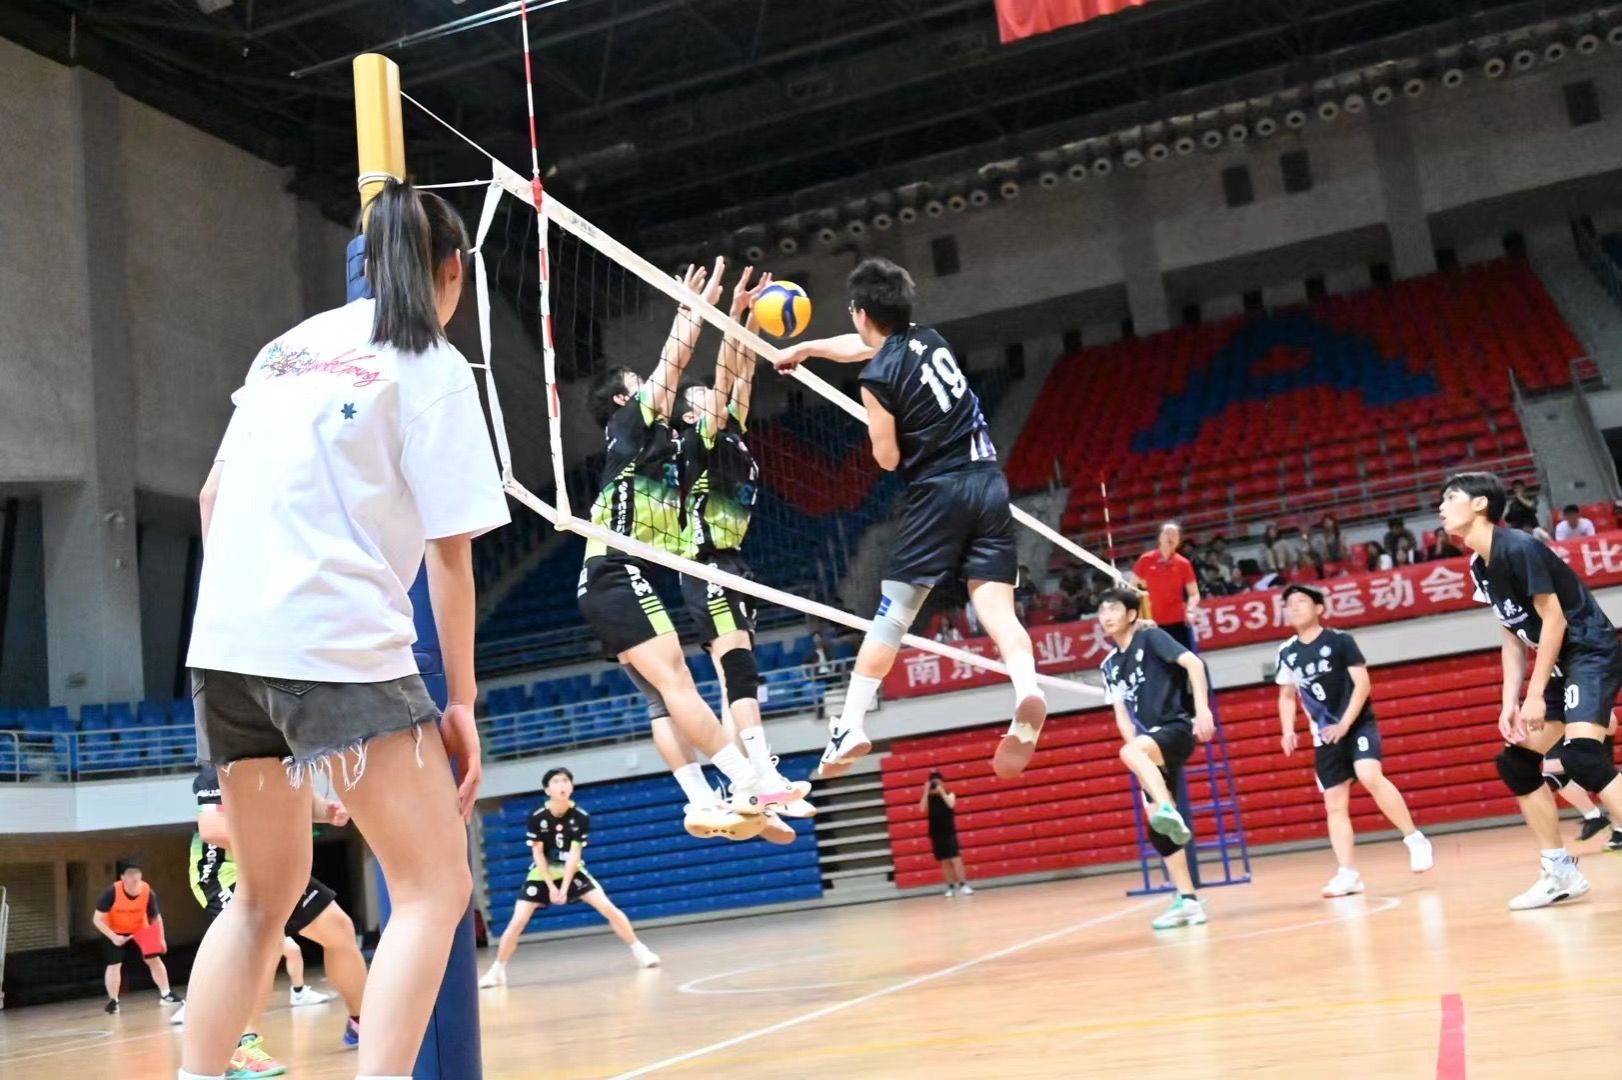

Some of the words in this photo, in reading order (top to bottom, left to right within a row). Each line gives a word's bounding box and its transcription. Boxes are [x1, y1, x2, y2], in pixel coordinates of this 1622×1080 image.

[920, 347, 967, 413] 19
[1357, 735, 1369, 752] 9
[555, 832, 565, 849] 6
